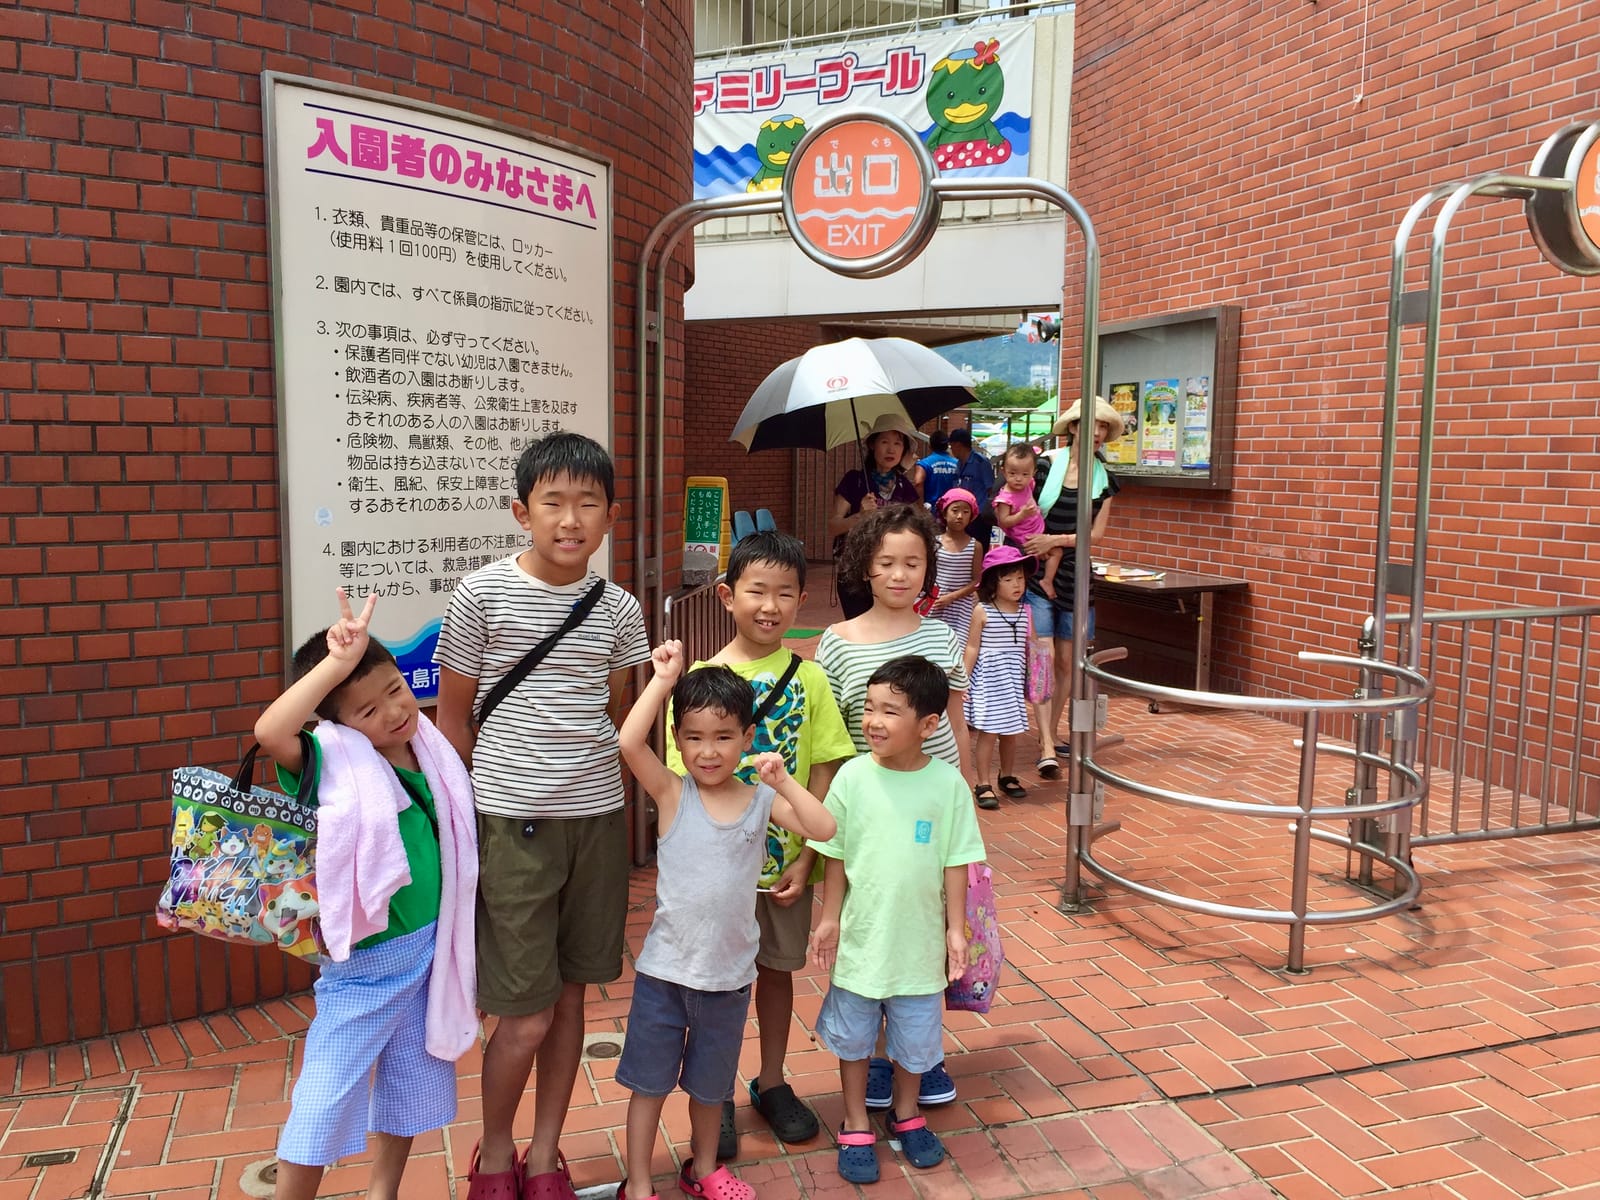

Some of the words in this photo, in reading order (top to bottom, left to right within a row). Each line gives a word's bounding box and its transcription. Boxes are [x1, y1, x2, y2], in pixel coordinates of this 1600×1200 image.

[307, 117, 597, 220] 入園者のみなさまへ
[814, 152, 899, 198] 出口
[332, 207, 553, 258] 衣類、貴重品等の保管には、ロッカー
[827, 223, 886, 247] EXIT
[334, 275, 593, 325] 園内では、すべて係員の指示に従ってください。
[335, 321, 540, 356] 次の事項は、必ず守ってください。
[349, 495, 520, 513] するおそれのある人の入園
